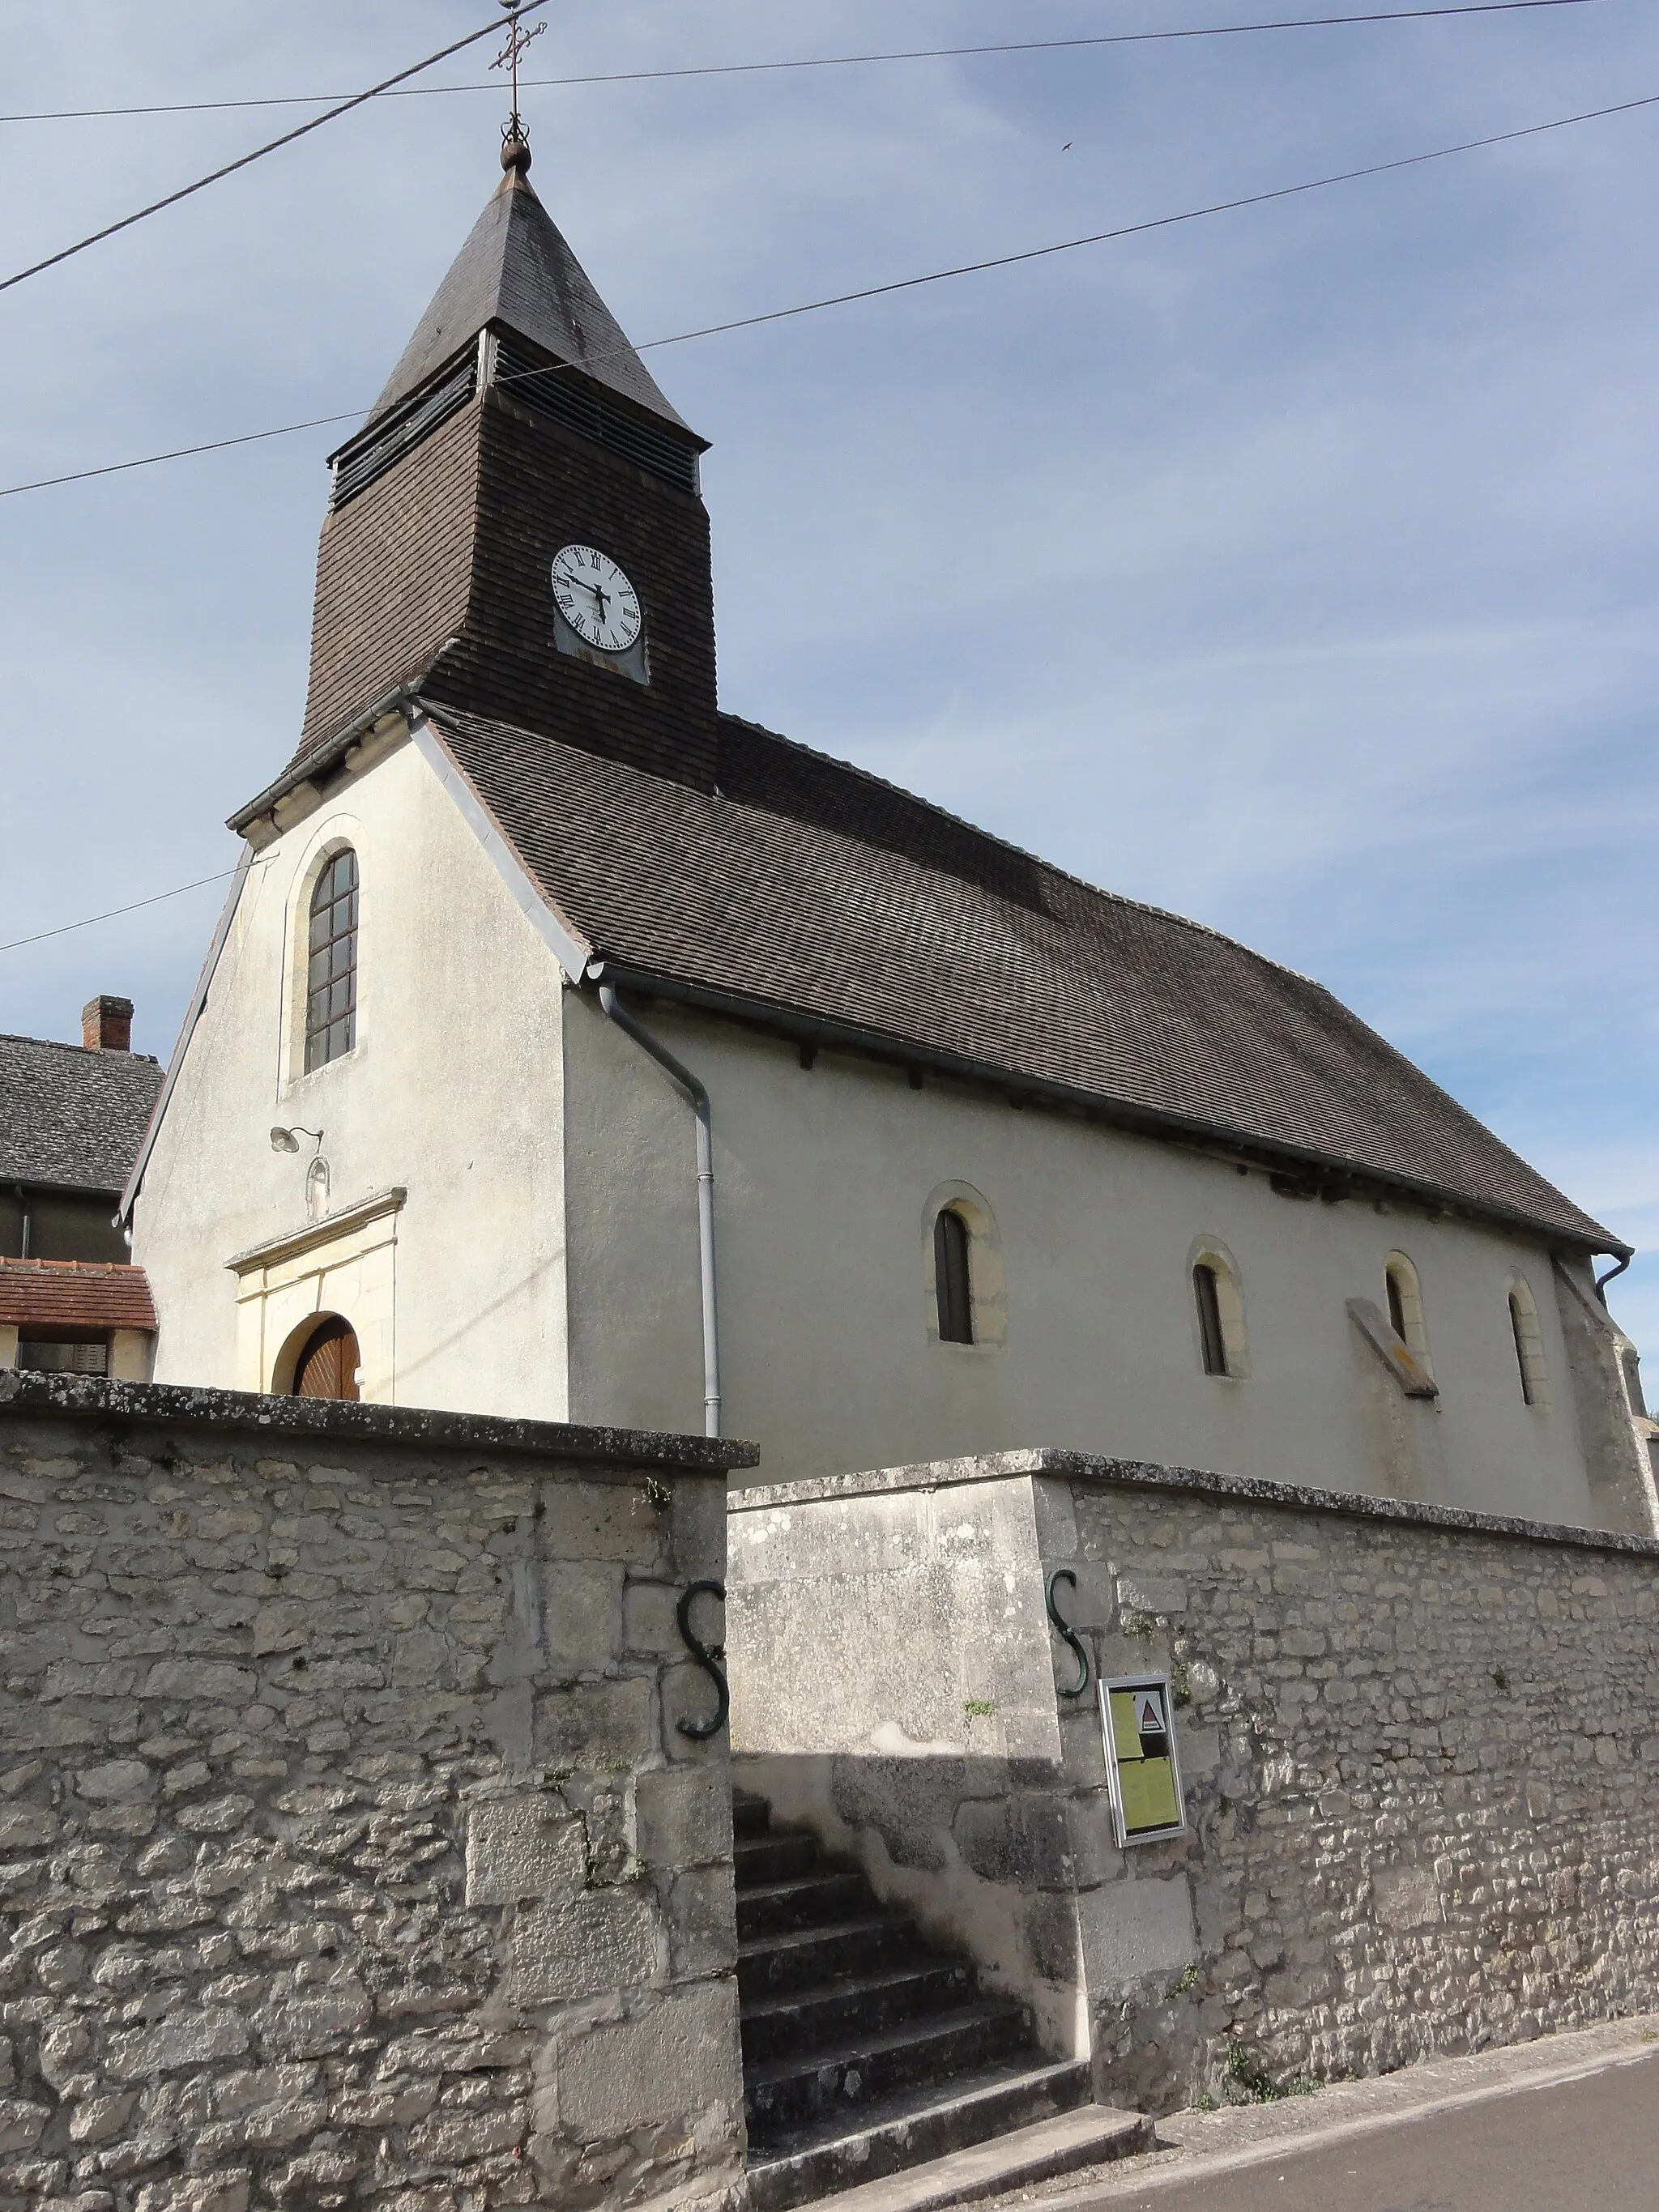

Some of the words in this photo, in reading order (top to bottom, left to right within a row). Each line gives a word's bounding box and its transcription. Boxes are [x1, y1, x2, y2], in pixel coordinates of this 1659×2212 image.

[561, 558, 574, 573] X
[591, 555, 601, 571] XII
[557, 574, 569, 588] IX
[608, 568, 618, 581] I
[560, 594, 575, 609] VIII
[574, 612, 586, 629] VII
[623, 607, 636, 620] III
[593, 625, 602, 642] VI
[609, 629, 619, 644] V
